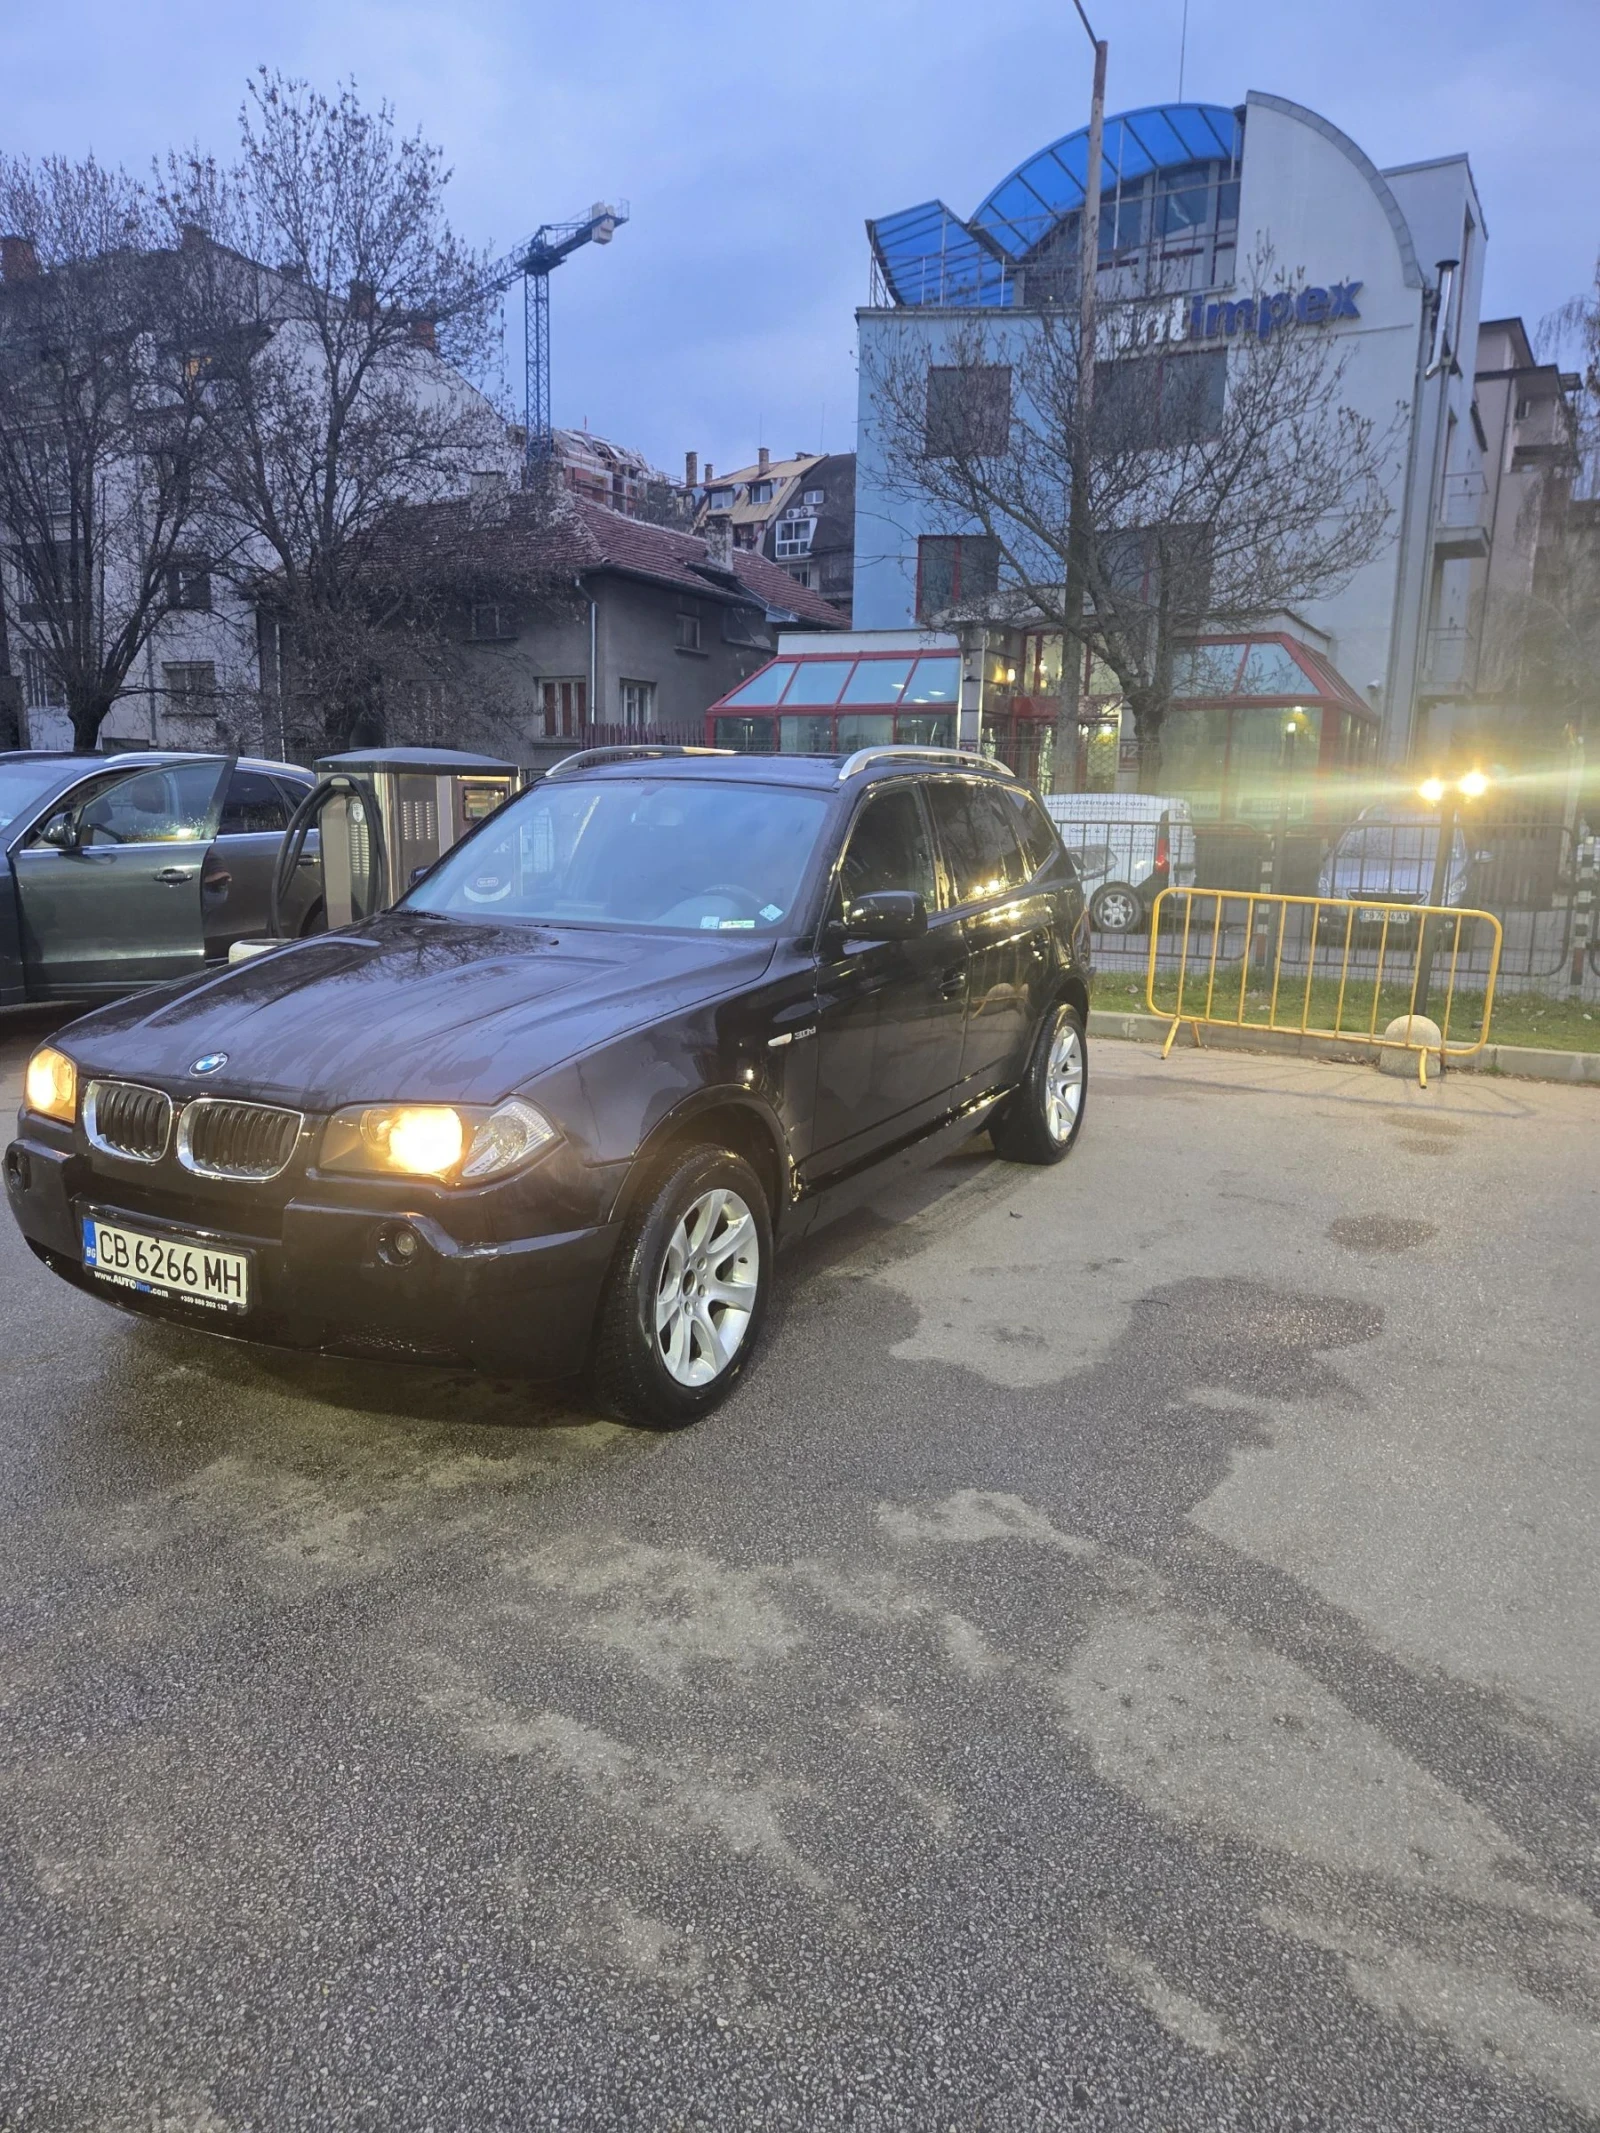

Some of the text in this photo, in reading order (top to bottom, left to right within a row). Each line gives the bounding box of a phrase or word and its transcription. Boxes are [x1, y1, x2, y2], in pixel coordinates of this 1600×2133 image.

[86, 1246, 96, 1258] BG
[100, 1230, 241, 1297] CB 6266 MH
